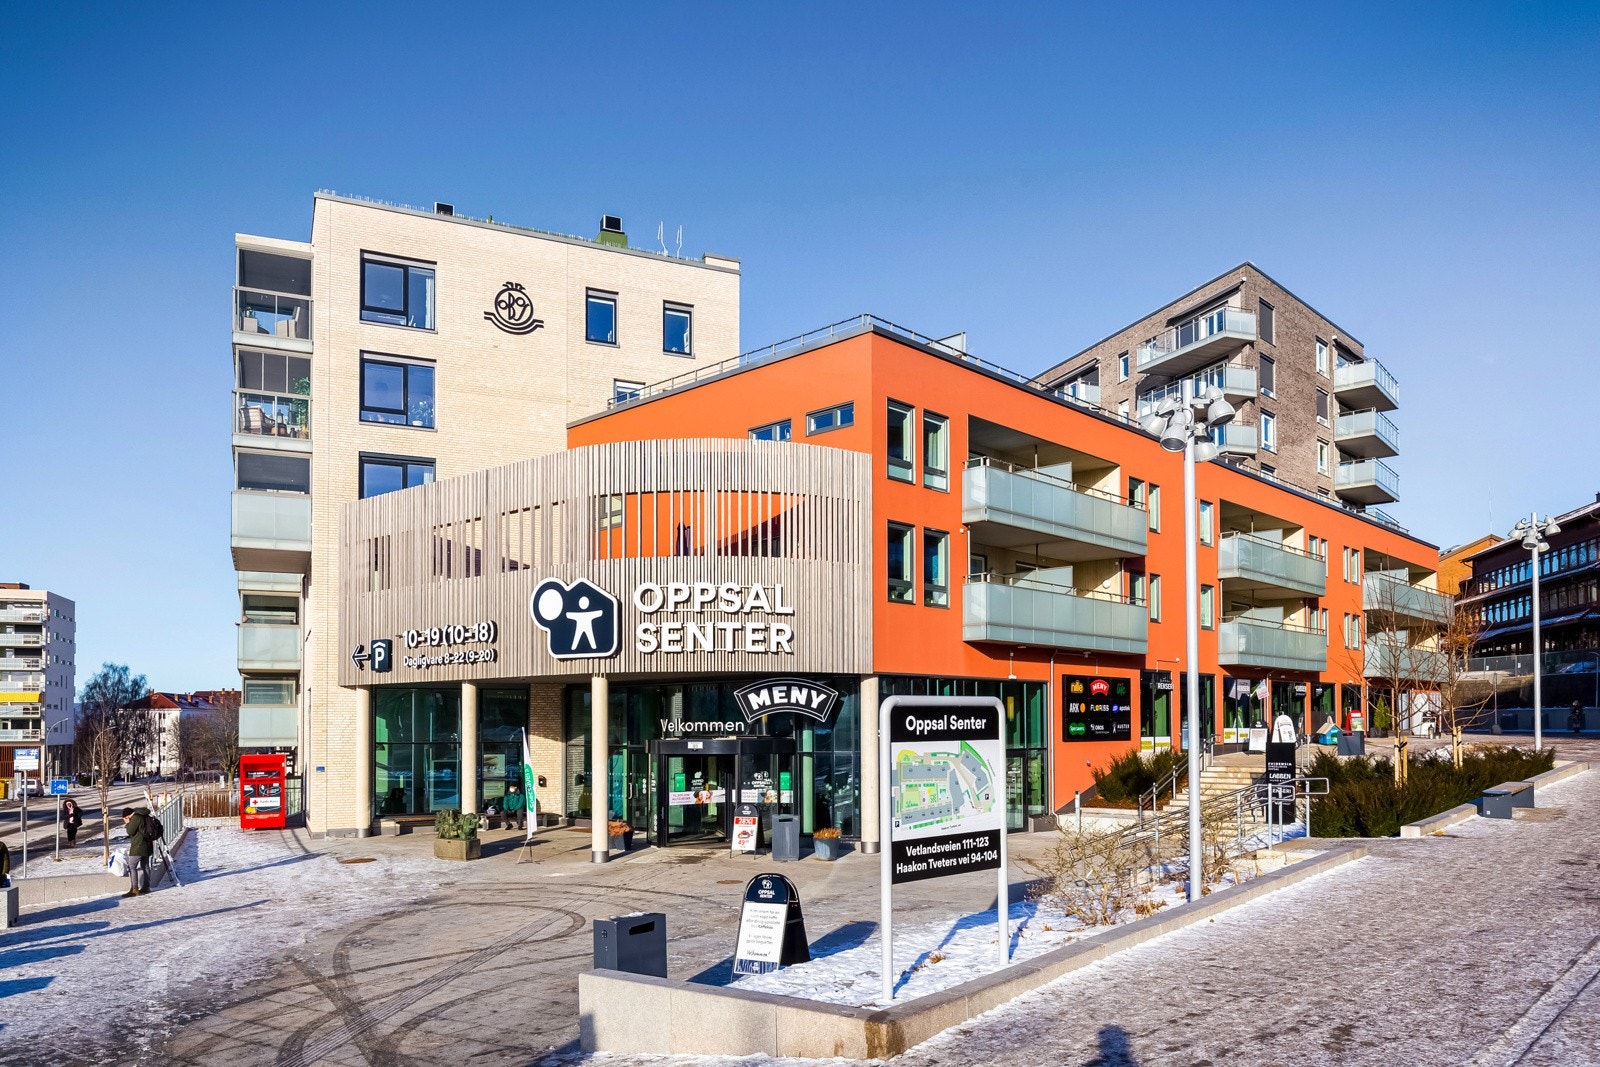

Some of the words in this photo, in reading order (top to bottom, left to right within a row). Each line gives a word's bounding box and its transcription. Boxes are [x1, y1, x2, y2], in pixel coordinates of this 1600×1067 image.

[633, 581, 794, 614] OPPSAL
[635, 621, 793, 653] SENTER
[374, 647, 385, 669] P
[403, 653, 443, 669] Dagligvare
[1092, 683, 1107, 691] MENY
[747, 685, 828, 711] MENY
[1069, 702, 1079, 713] ARK
[660, 718, 745, 733] Velkommen
[905, 714, 947, 735] Oppsal
[949, 714, 987, 730] Senter
[1269, 772, 1291, 780] LABBEN
[906, 841, 961, 857] Vetlandsveien
[962, 836, 989, 850] 111-123
[896, 861, 927, 874] Haakon
[928, 857, 957, 869] Tveters
[958, 853, 970, 865] vei
[970, 850, 998, 863] 94-104
